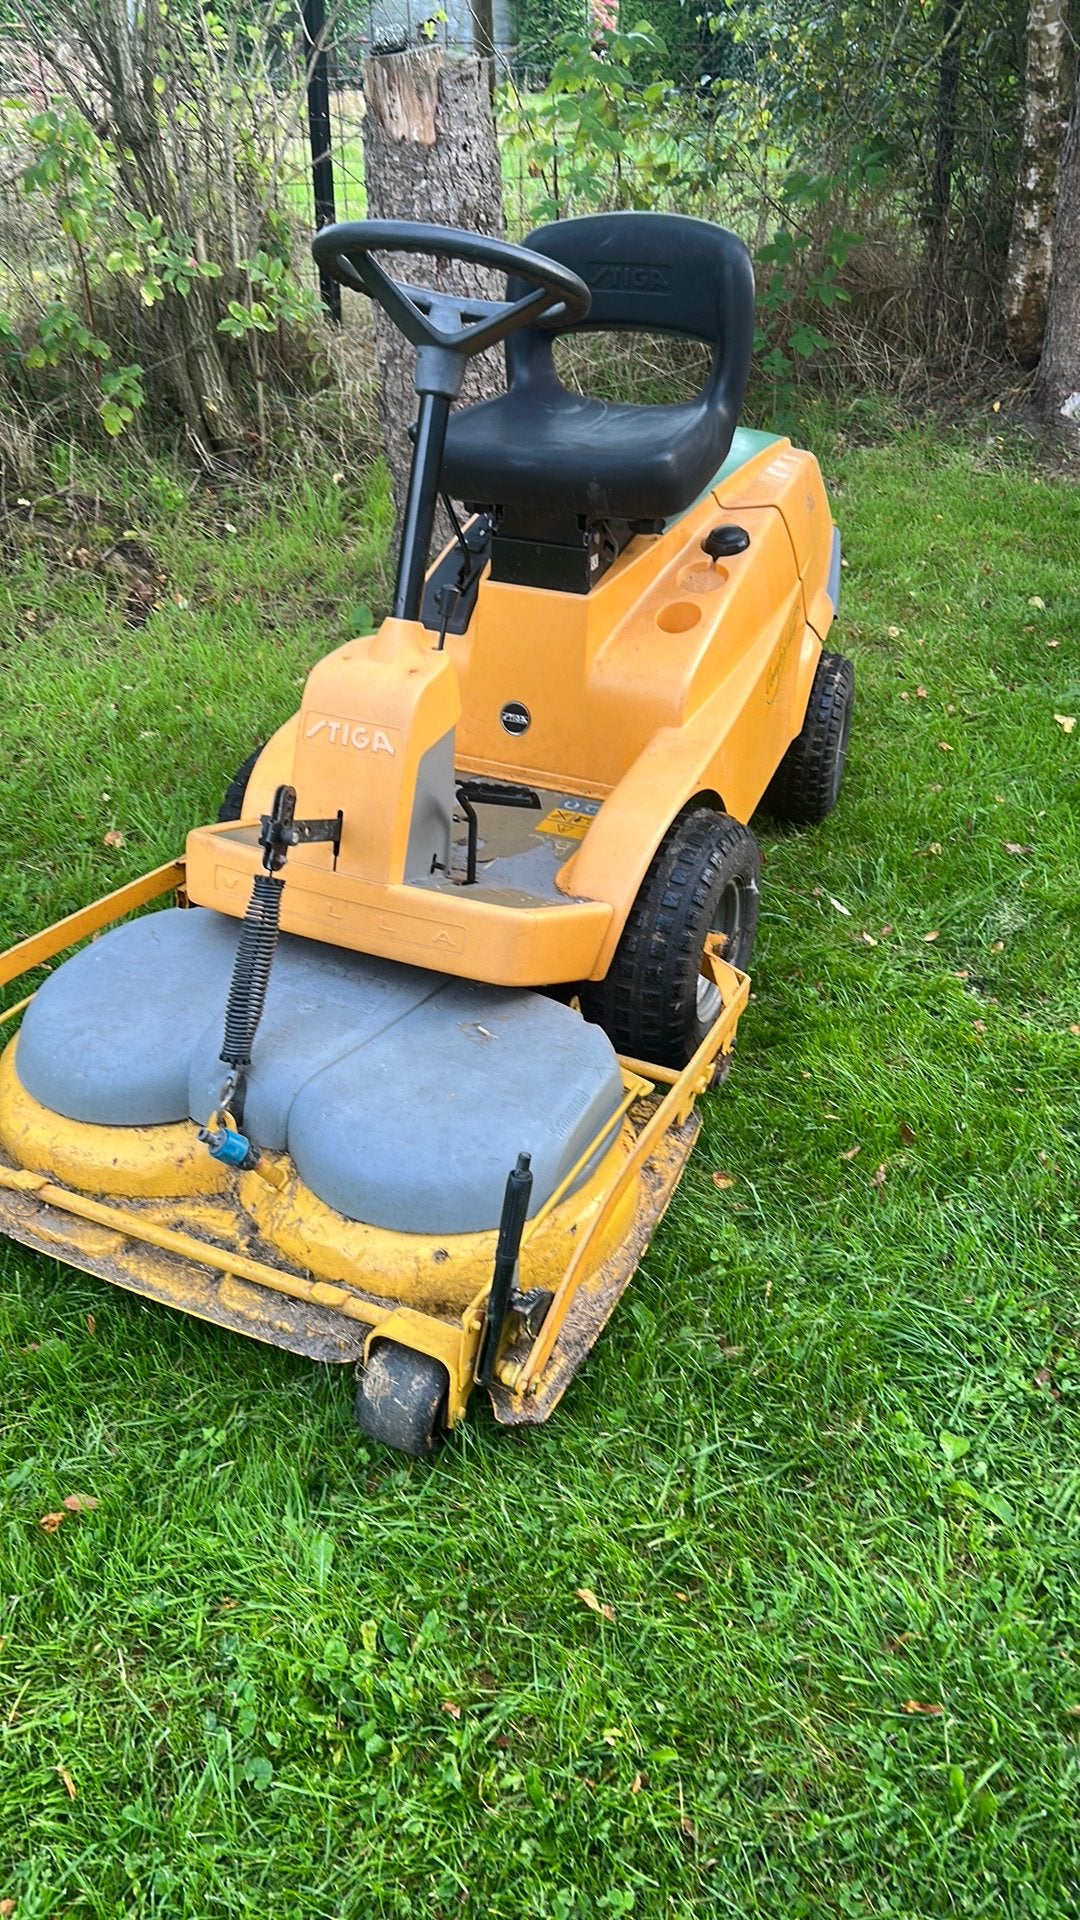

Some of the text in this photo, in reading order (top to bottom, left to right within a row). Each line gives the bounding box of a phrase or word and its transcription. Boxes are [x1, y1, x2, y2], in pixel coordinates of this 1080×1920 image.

[591, 266, 669, 288] STIGA
[305, 719, 396, 756] STIGA
[221, 874, 456, 947] VLLA
